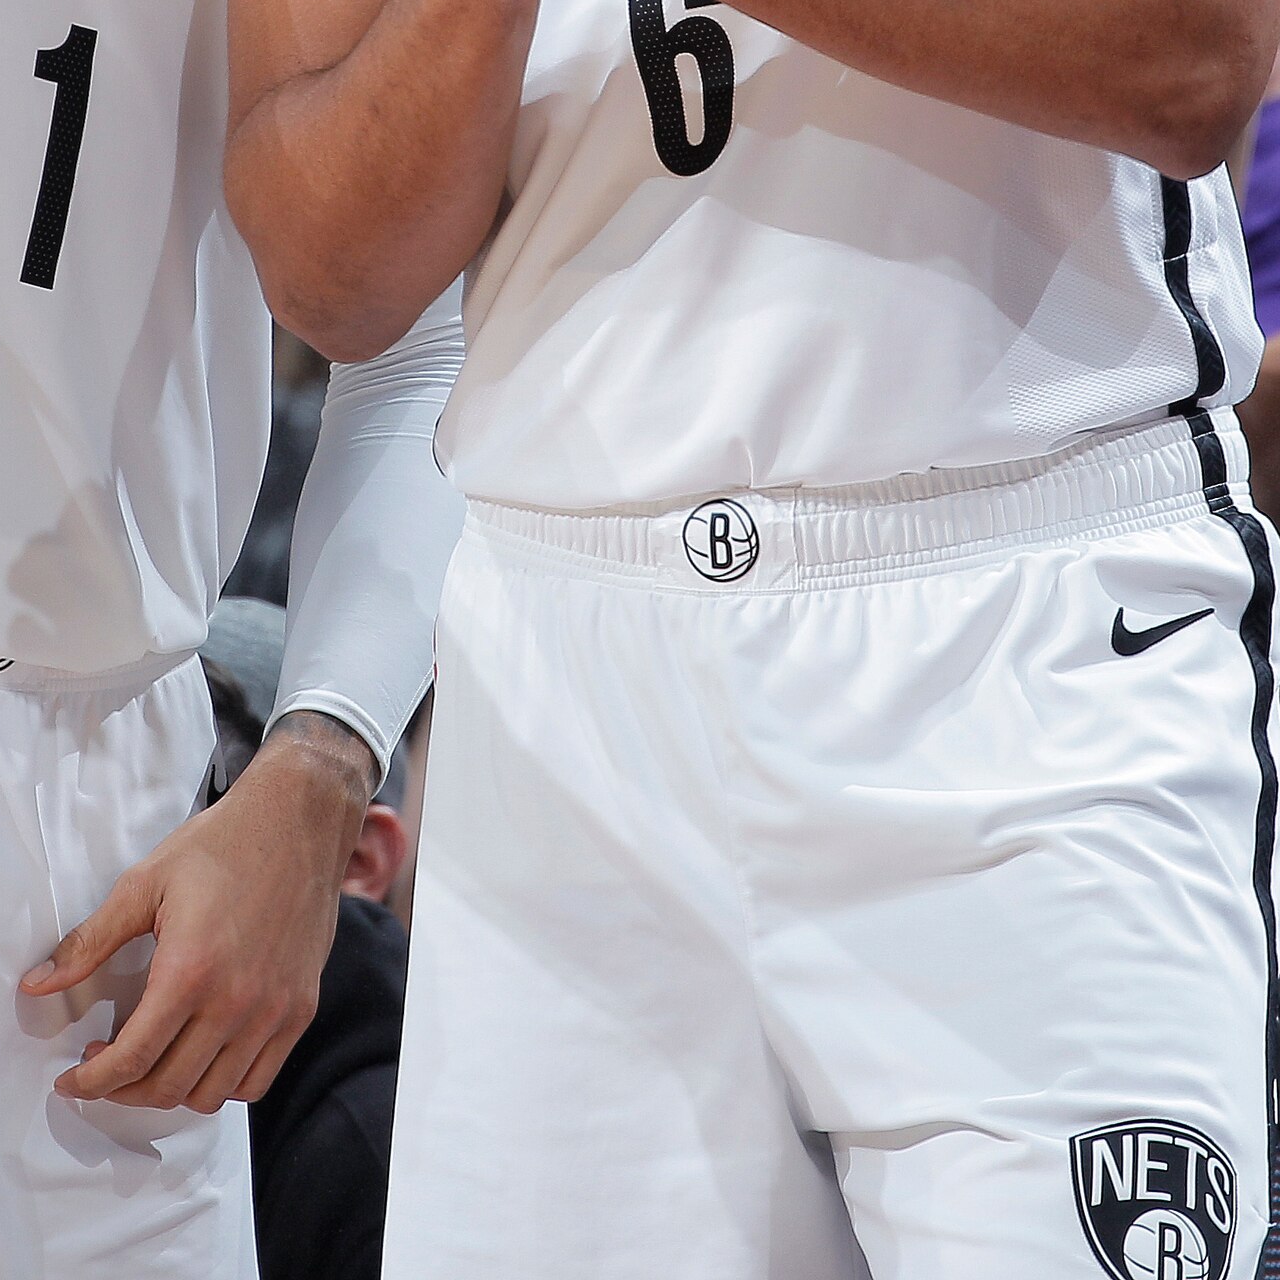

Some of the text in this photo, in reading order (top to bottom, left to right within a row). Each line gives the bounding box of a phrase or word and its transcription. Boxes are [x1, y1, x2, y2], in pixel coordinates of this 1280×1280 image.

[20, 24, 98, 290] 1
[710, 513, 733, 569] B
[1090, 1132, 1231, 1235] NETS
